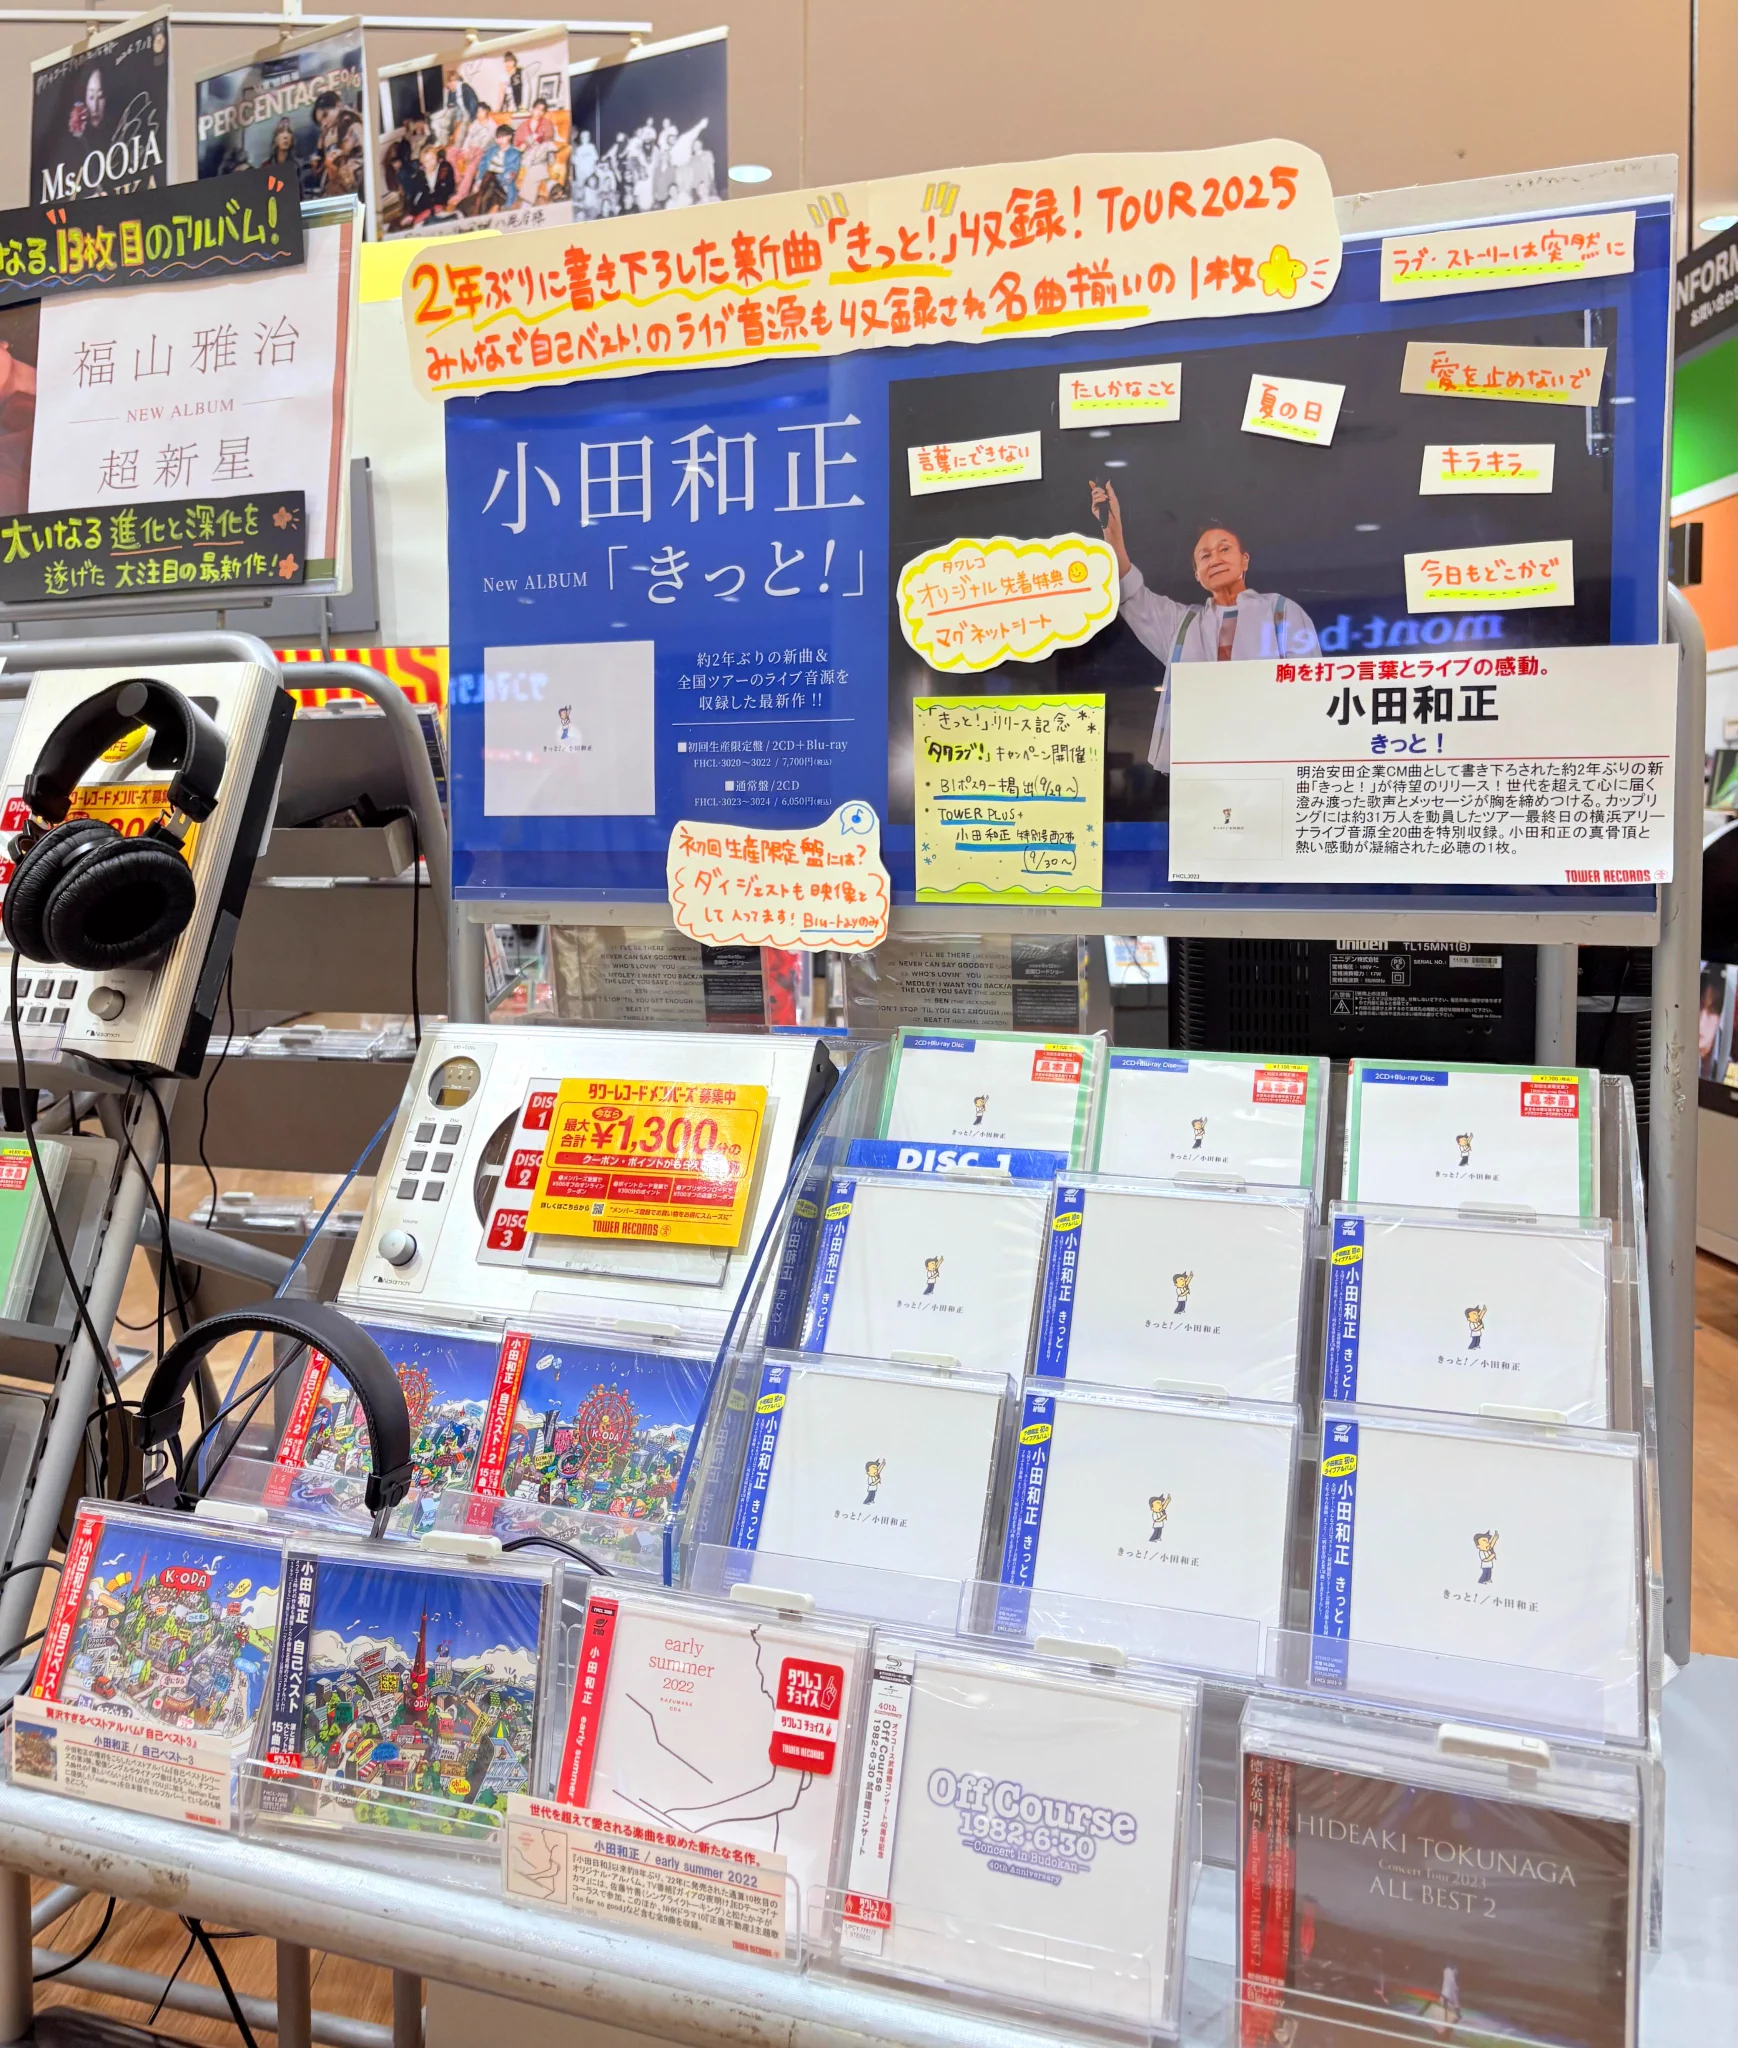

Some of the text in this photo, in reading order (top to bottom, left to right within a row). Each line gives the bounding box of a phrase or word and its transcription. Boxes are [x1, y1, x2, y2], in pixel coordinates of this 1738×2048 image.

[40, 131, 163, 204] Ms.OOJA
[1393, 230, 1625, 276] ラブ・ストーリーは突然に
[73, 315, 300, 388] 福山雅治
[1431, 351, 1590, 391] 愛を止めないで
[1072, 379, 1176, 399] たしかなこと
[127, 399, 235, 423] NEW ALBUM
[1261, 383, 1324, 424] 夏の日
[98, 437, 254, 494] 超新星
[918, 445, 1030, 473] 言葉にできない
[1442, 448, 1522, 475] キラキラ
[482, 413, 865, 535] 小田和正
[942, 557, 986, 574] タワレコ
[1420, 557, 1560, 587] 今日もどこかで
[483, 577, 518, 592] New
[525, 571, 588, 590] ALBUM
[936, 613, 1051, 647] マグネットシート
[677, 669, 849, 690] 全国ツアーのライブ音源を
[1276, 656, 1548, 684] 胸を打つ言葉とライブの感動。
[1327, 684, 1498, 725] 小田和正
[1297, 762, 1664, 783] 明治安田企業CM曲として書き下ろされた約2年ぶりの新
[938, 808, 982, 820] TOWER
[1296, 794, 1657, 809] 澄み渡った歌声とメッセージが胸を締めつける。カップリ
[1296, 810, 1665, 824] ングには約31万人を動員したツアー最終日の横浜アリー
[1296, 825, 1650, 839] ナライブ音源全20曲を特別収録。小田和正の真骨頂と
[1296, 840, 1517, 855] 熱い感動が凝縮された必聴の1枚。
[1565, 869, 1651, 882] TOWER RECORDS
[538, 1114, 545, 1128] 1
[564, 1119, 589, 1132] 最大
[561, 1134, 586, 1148] 合計
[519, 1170, 529, 1186] 2
[540, 1202, 590, 1212] 詳しくはこちらから
[503, 1231, 513, 1247] 3
[593, 1220, 658, 1236] TOWER RECORDS
[754, 1416, 777, 1490] 小田和正
[1024, 1447, 1046, 1526] 小田和正
[1334, 1480, 1353, 1566] 小田和正
[665, 1637, 704, 1657] early
[582, 1647, 600, 1704] 小田和正
[649, 1656, 715, 1678] summer
[787, 1669, 822, 1690] タワレコ
[663, 1677, 694, 1693] 2022
[786, 1686, 820, 1708] チョイス
[576, 1716, 587, 1747] early
[928, 1768, 1137, 1843] Off Course
[530, 1804, 761, 1867] 世代を超えて愛される楽曲を収めた新たな名作。
[974, 1840, 1078, 1873] Concert in Budokan
[1296, 1814, 1576, 1887] HIDEAKI TOKUNAGA
[594, 1840, 640, 1861] 小田和正
[656, 1855, 680, 1872] early
[684, 1862, 724, 1880] summer
[728, 1870, 758, 1888] 2022
[1010, 1865, 1061, 1885] Anniversary
[1379, 1858, 1486, 1890] Concert Tour 2023
[1370, 1876, 1497, 1919] ALL BEST 2
